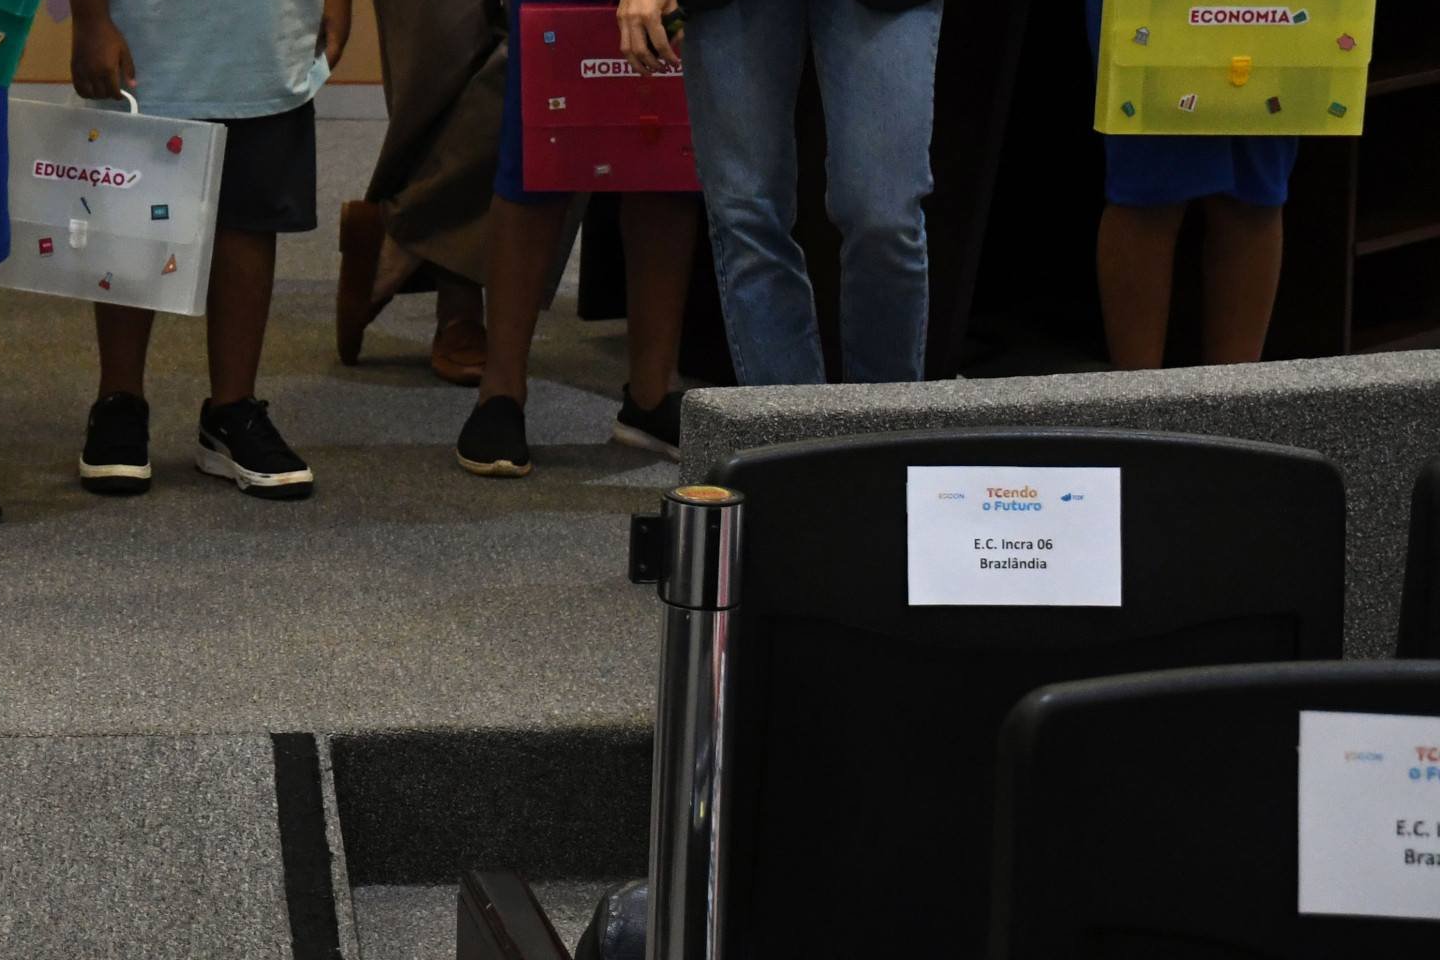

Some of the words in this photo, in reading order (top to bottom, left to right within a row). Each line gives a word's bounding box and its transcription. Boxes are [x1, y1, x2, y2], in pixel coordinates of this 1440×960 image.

[1190, 9, 1290, 25] ECONOMIA
[34, 161, 126, 188] EDUCAÇÃO
[985, 485, 1038, 499] TCendo
[993, 499, 1042, 512] Futuro
[974, 538, 998, 551] E.C.
[1001, 538, 1034, 551] Incra
[1036, 538, 1053, 551] 06
[979, 556, 1048, 571] Brazlândia
[1395, 819, 1431, 837] E.C.
